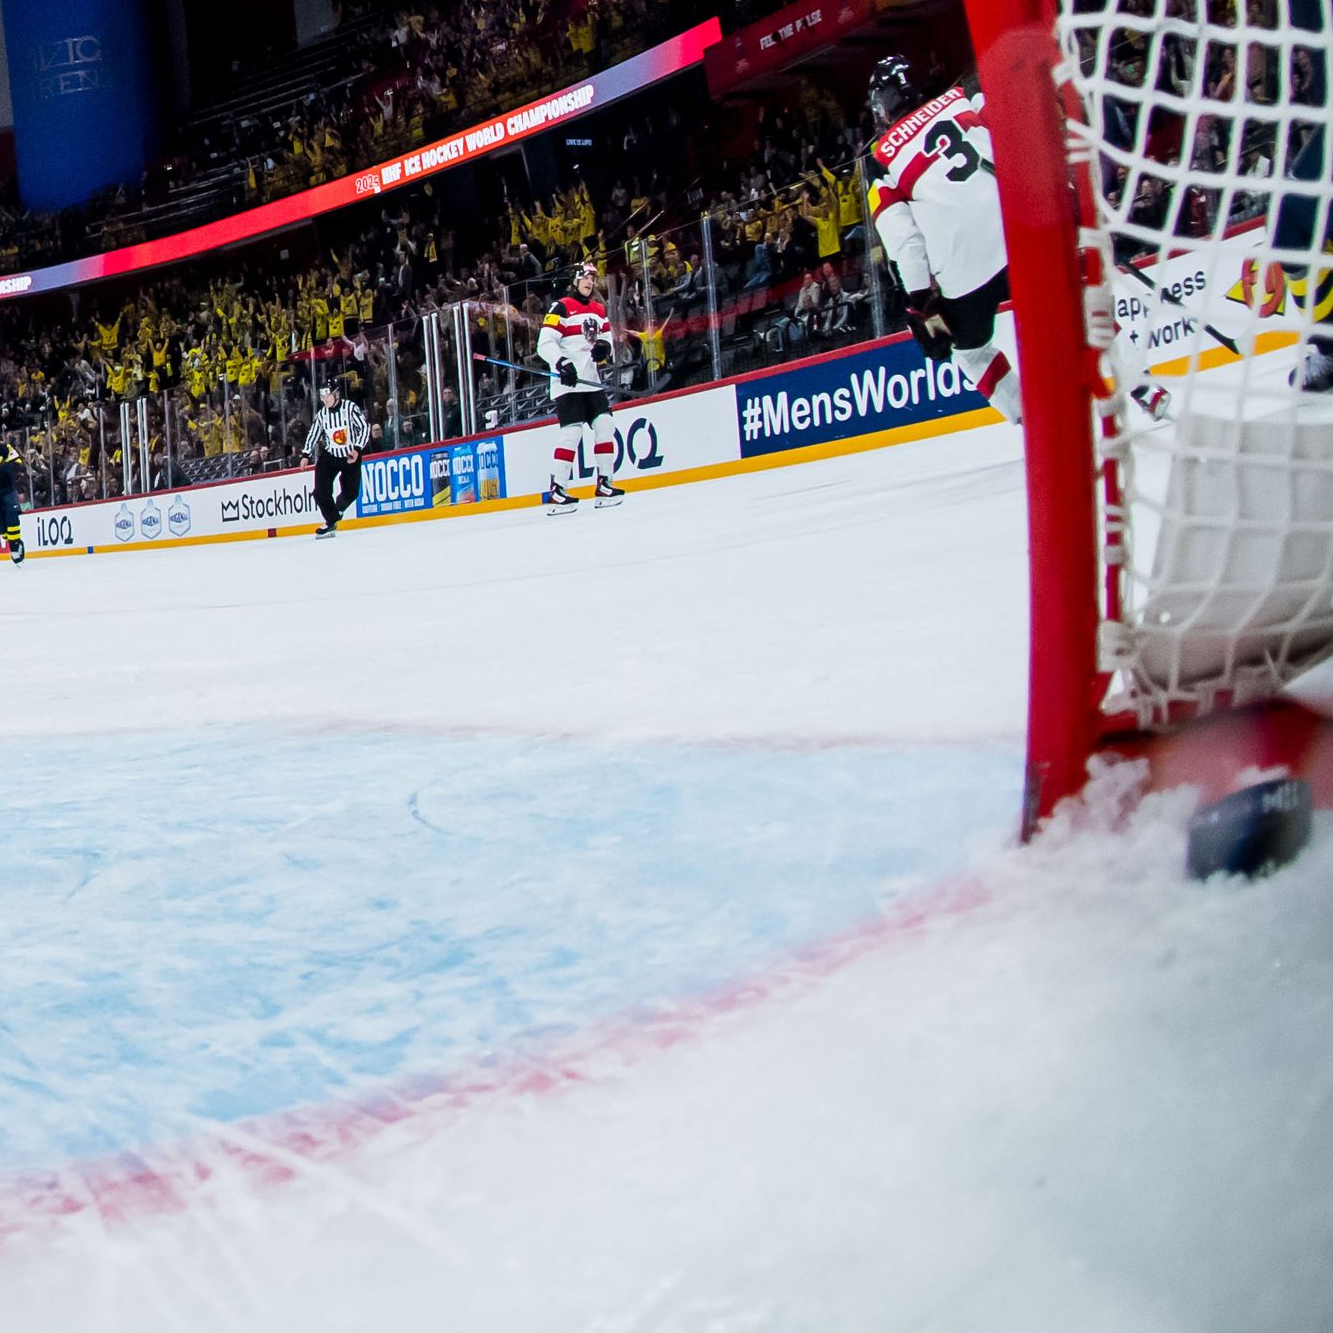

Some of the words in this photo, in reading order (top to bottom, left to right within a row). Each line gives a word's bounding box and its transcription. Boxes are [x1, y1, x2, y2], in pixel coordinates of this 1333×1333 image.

[404, 156, 422, 177] ICE
[422, 137, 466, 169] HOCKEY
[466, 122, 506, 152] WORLD
[506, 84, 595, 136] CHAMPIONSHIP
[880, 88, 962, 158] SCHNEIDER
[361, 454, 424, 505] NOCCO
